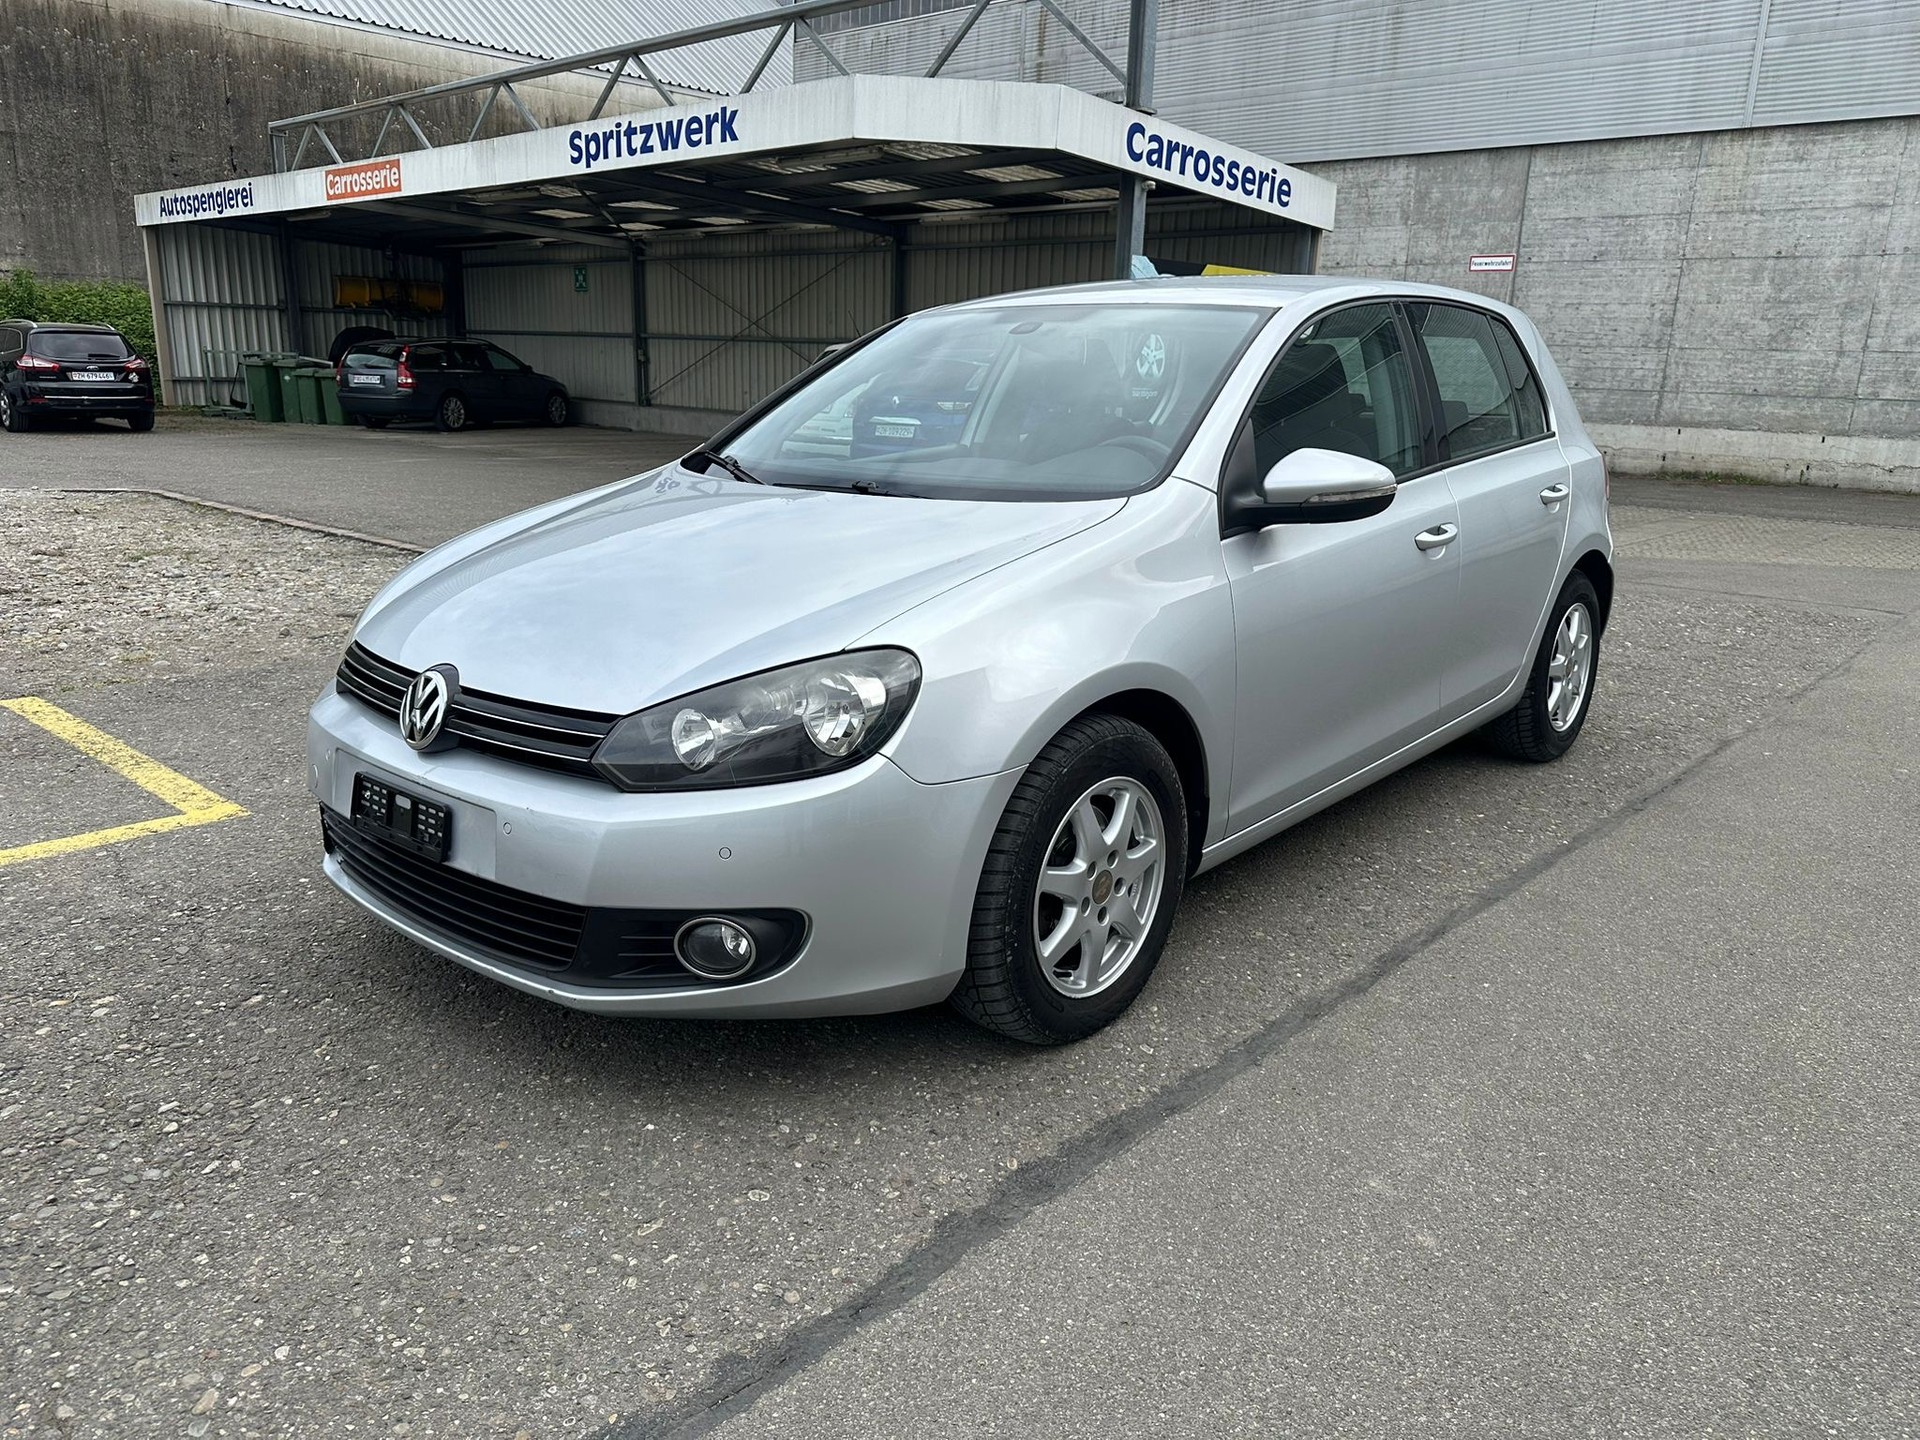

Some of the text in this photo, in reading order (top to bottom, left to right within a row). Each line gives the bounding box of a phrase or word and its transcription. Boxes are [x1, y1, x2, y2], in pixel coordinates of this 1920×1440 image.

[569, 106, 739, 168] Spritzwerk
[326, 164, 400, 195] Carrosserie
[1126, 122, 1292, 207] Carrosserie
[160, 182, 254, 218] Autospenglerei
